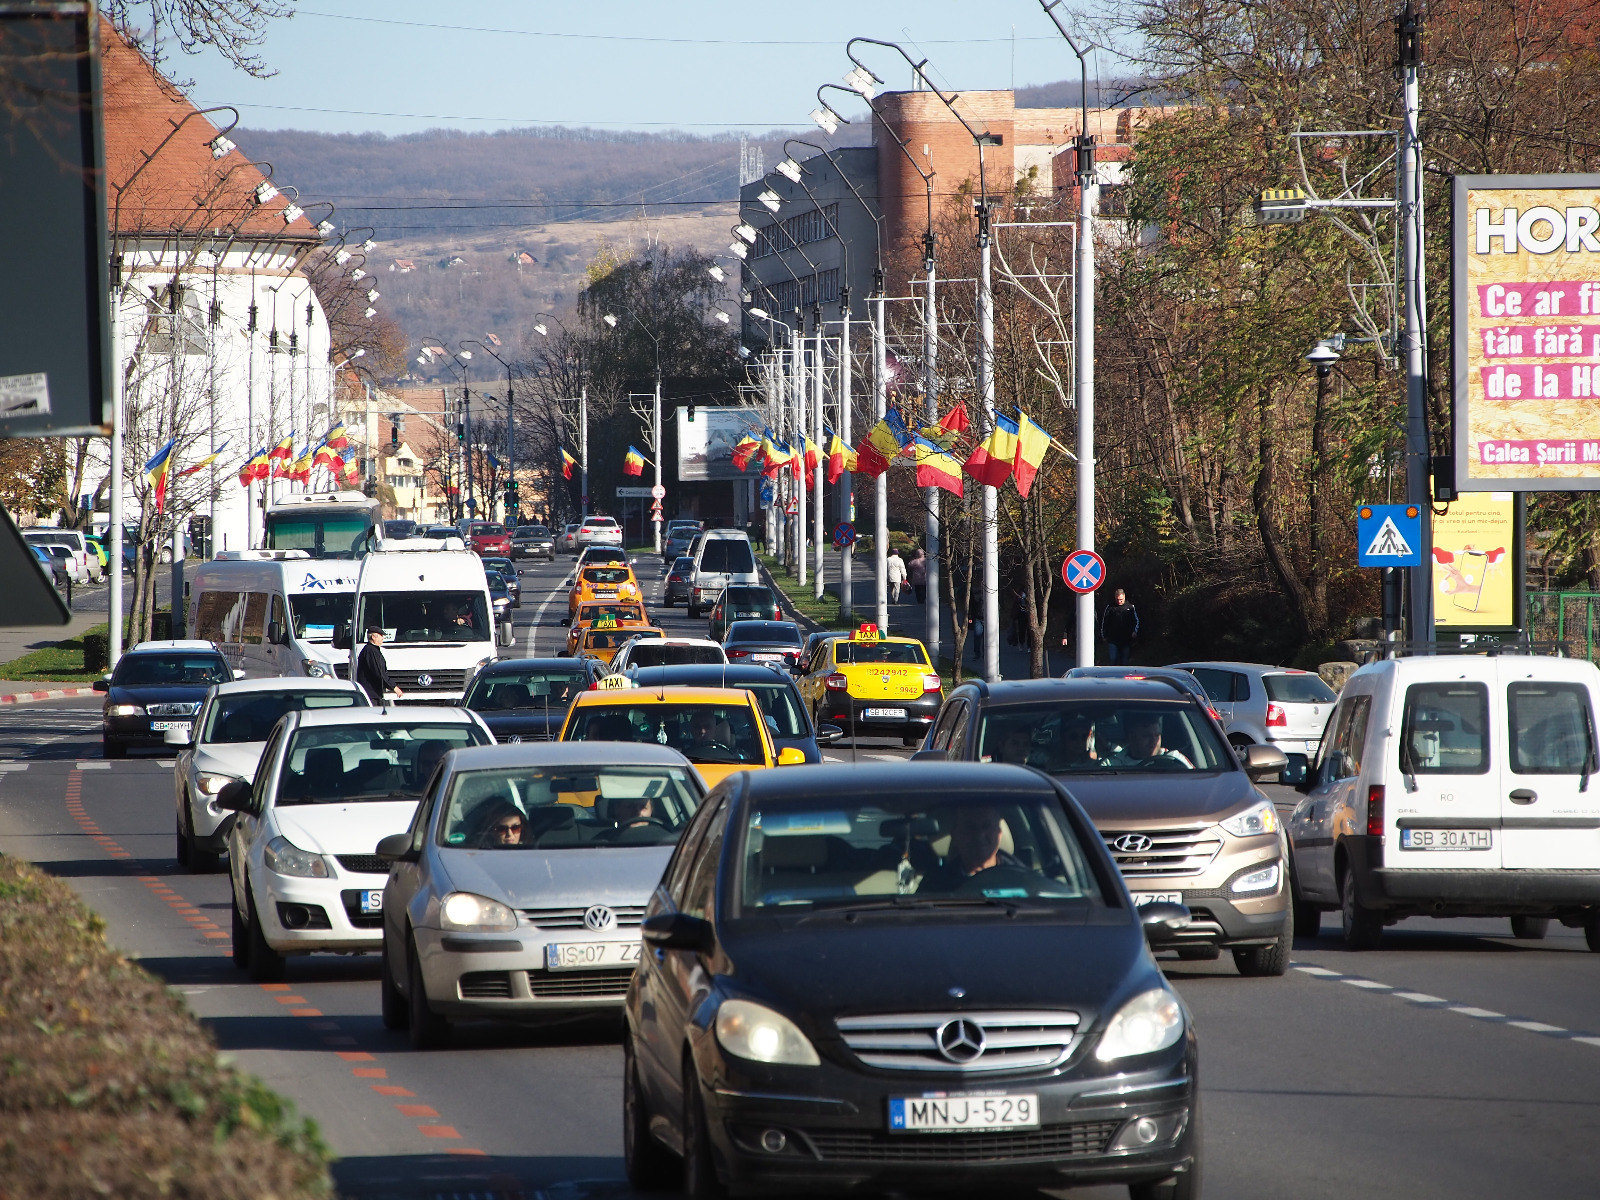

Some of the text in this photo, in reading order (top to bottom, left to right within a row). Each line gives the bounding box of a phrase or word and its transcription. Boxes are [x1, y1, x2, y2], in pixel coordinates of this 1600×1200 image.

[1476, 206, 1600, 254] HOR
[1486, 284, 1522, 315] Ce
[1535, 291, 1565, 315] ar
[1485, 327, 1582, 354] tău fără
[1488, 366, 1521, 397] de
[1534, 366, 1558, 397] la
[1483, 442, 1600, 467] Calea Șurii M
[859, 631, 877, 639] TAXI
[873, 668, 908, 676] 242942
[603, 677, 623, 689] TAXI
[899, 686, 918, 694] 9942
[1440, 793, 1454, 801] RO
[1413, 831, 1434, 846] SB
[1440, 831, 1457, 846] 30
[1460, 831, 1488, 846] ATH
[371, 893, 381, 907] S
[562, 946, 578, 964] IS
[585, 945, 606, 962] 07
[911, 1098, 1031, 1126] MNJ-529
